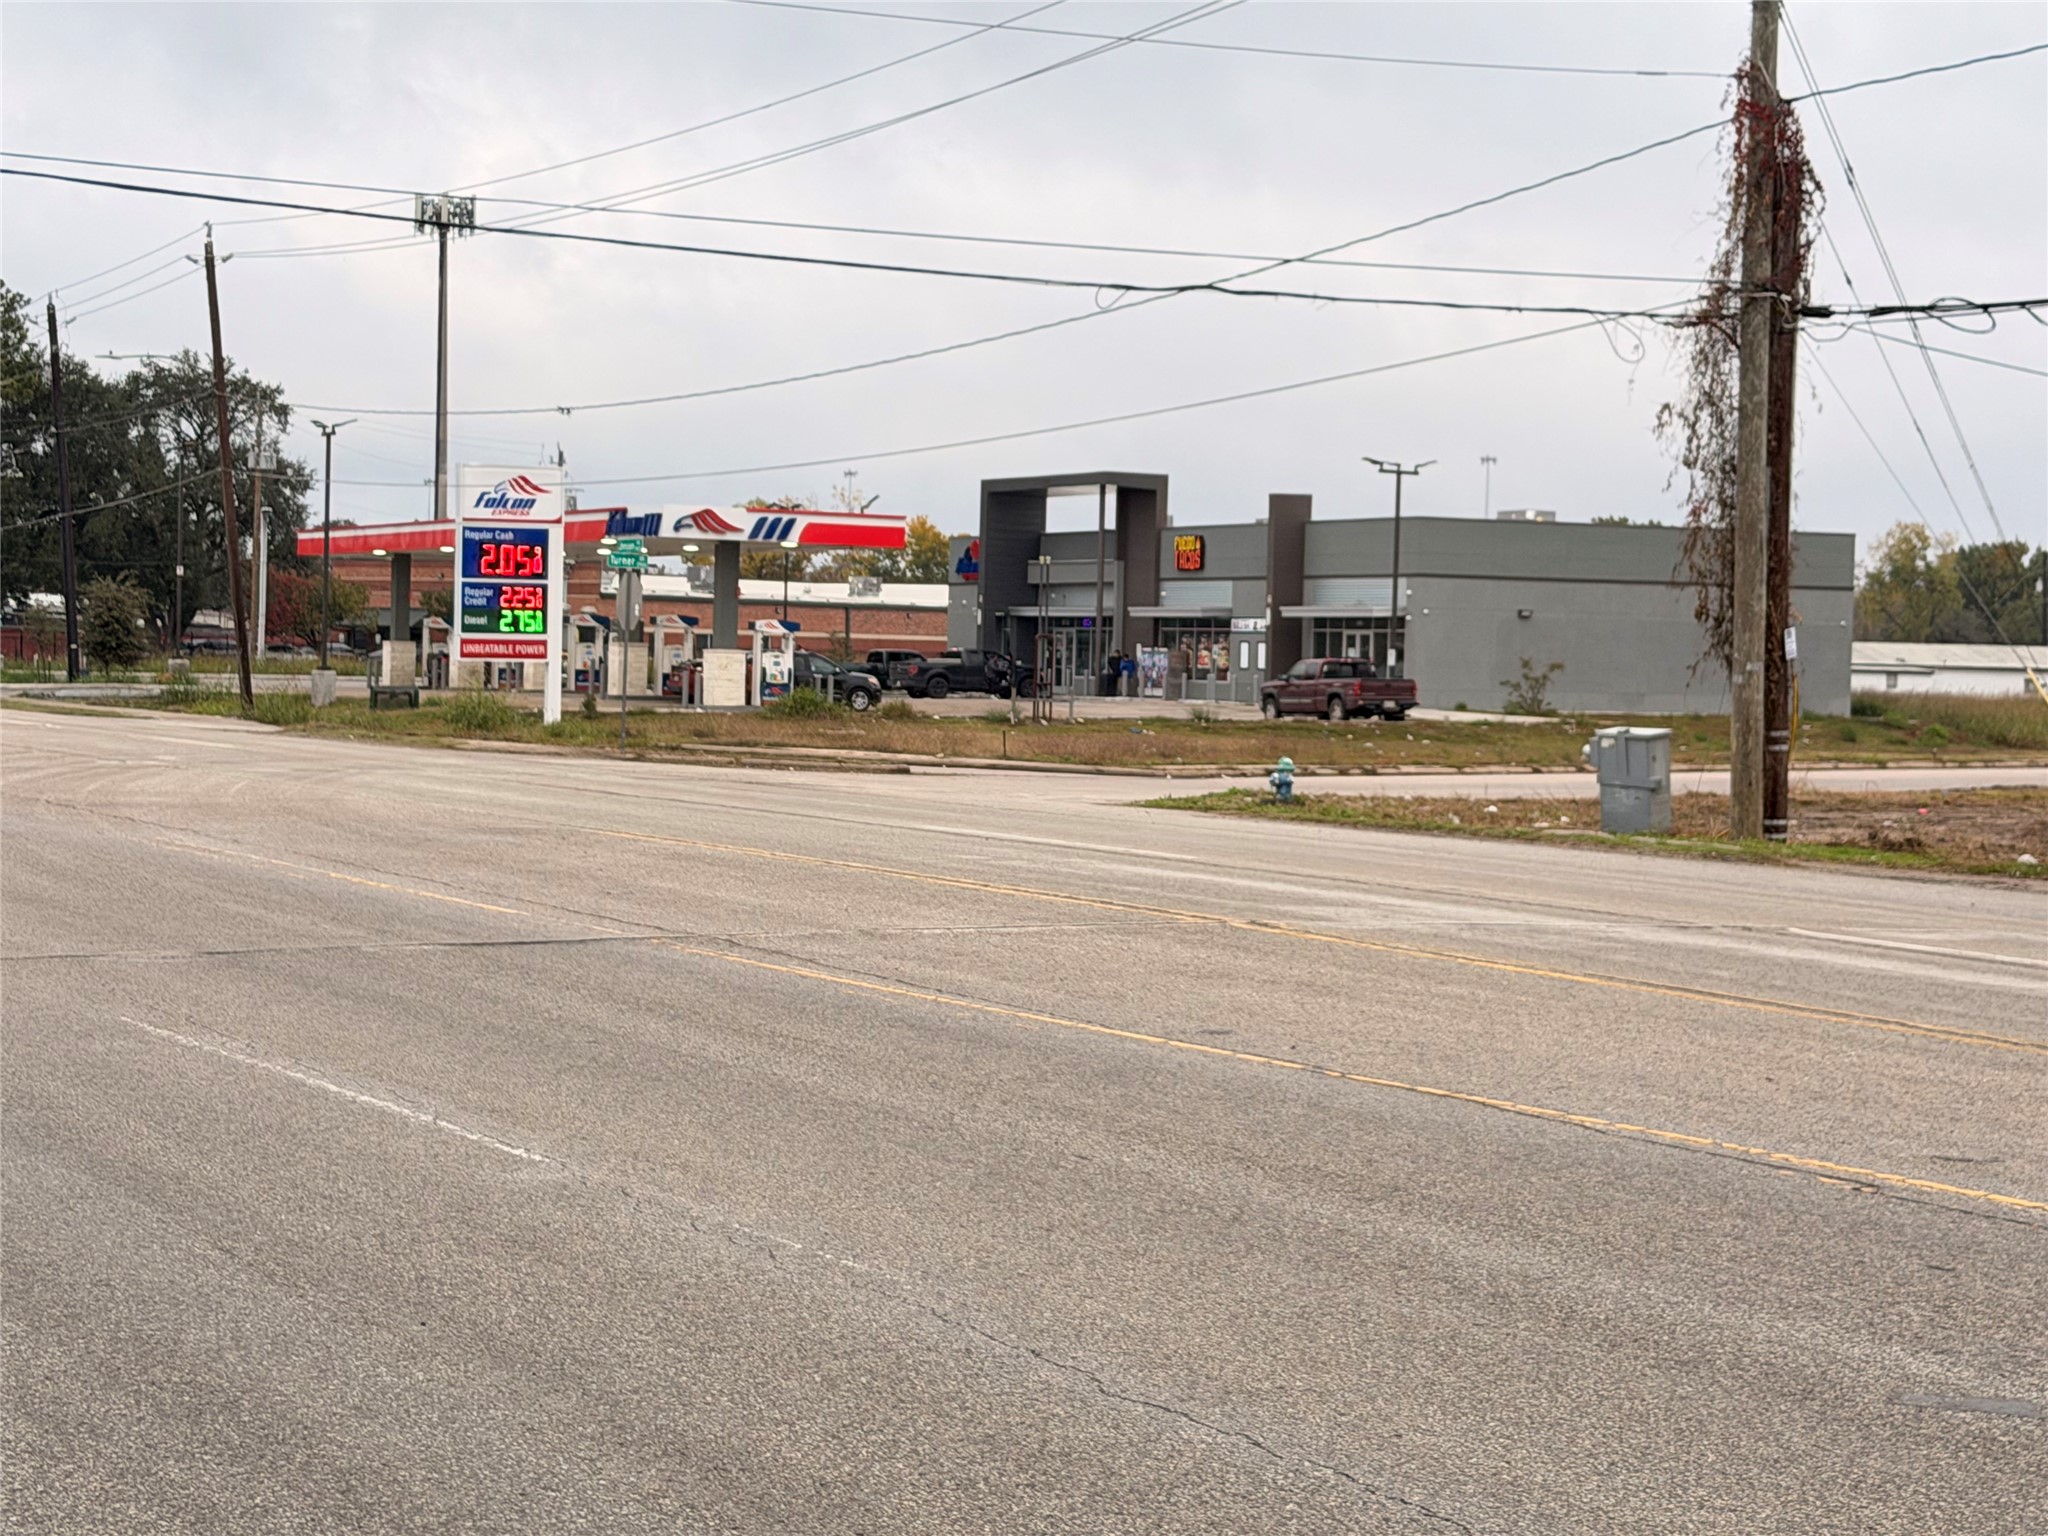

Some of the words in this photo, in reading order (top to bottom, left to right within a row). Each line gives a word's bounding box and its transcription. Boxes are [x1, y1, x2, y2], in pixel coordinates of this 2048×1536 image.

[473, 491, 537, 509] Falcon
[464, 529, 493, 541] Regular
[495, 530, 514, 540] Cash
[611, 554, 635, 565] Turner
[1174, 550, 1200, 570] TACOS
[464, 586, 493, 598] Regular
[464, 596, 487, 606] Credit
[464, 615, 488, 625] Diesel
[462, 643, 513, 655] UNBEATABLE
[515, 645, 545, 655] POWER
